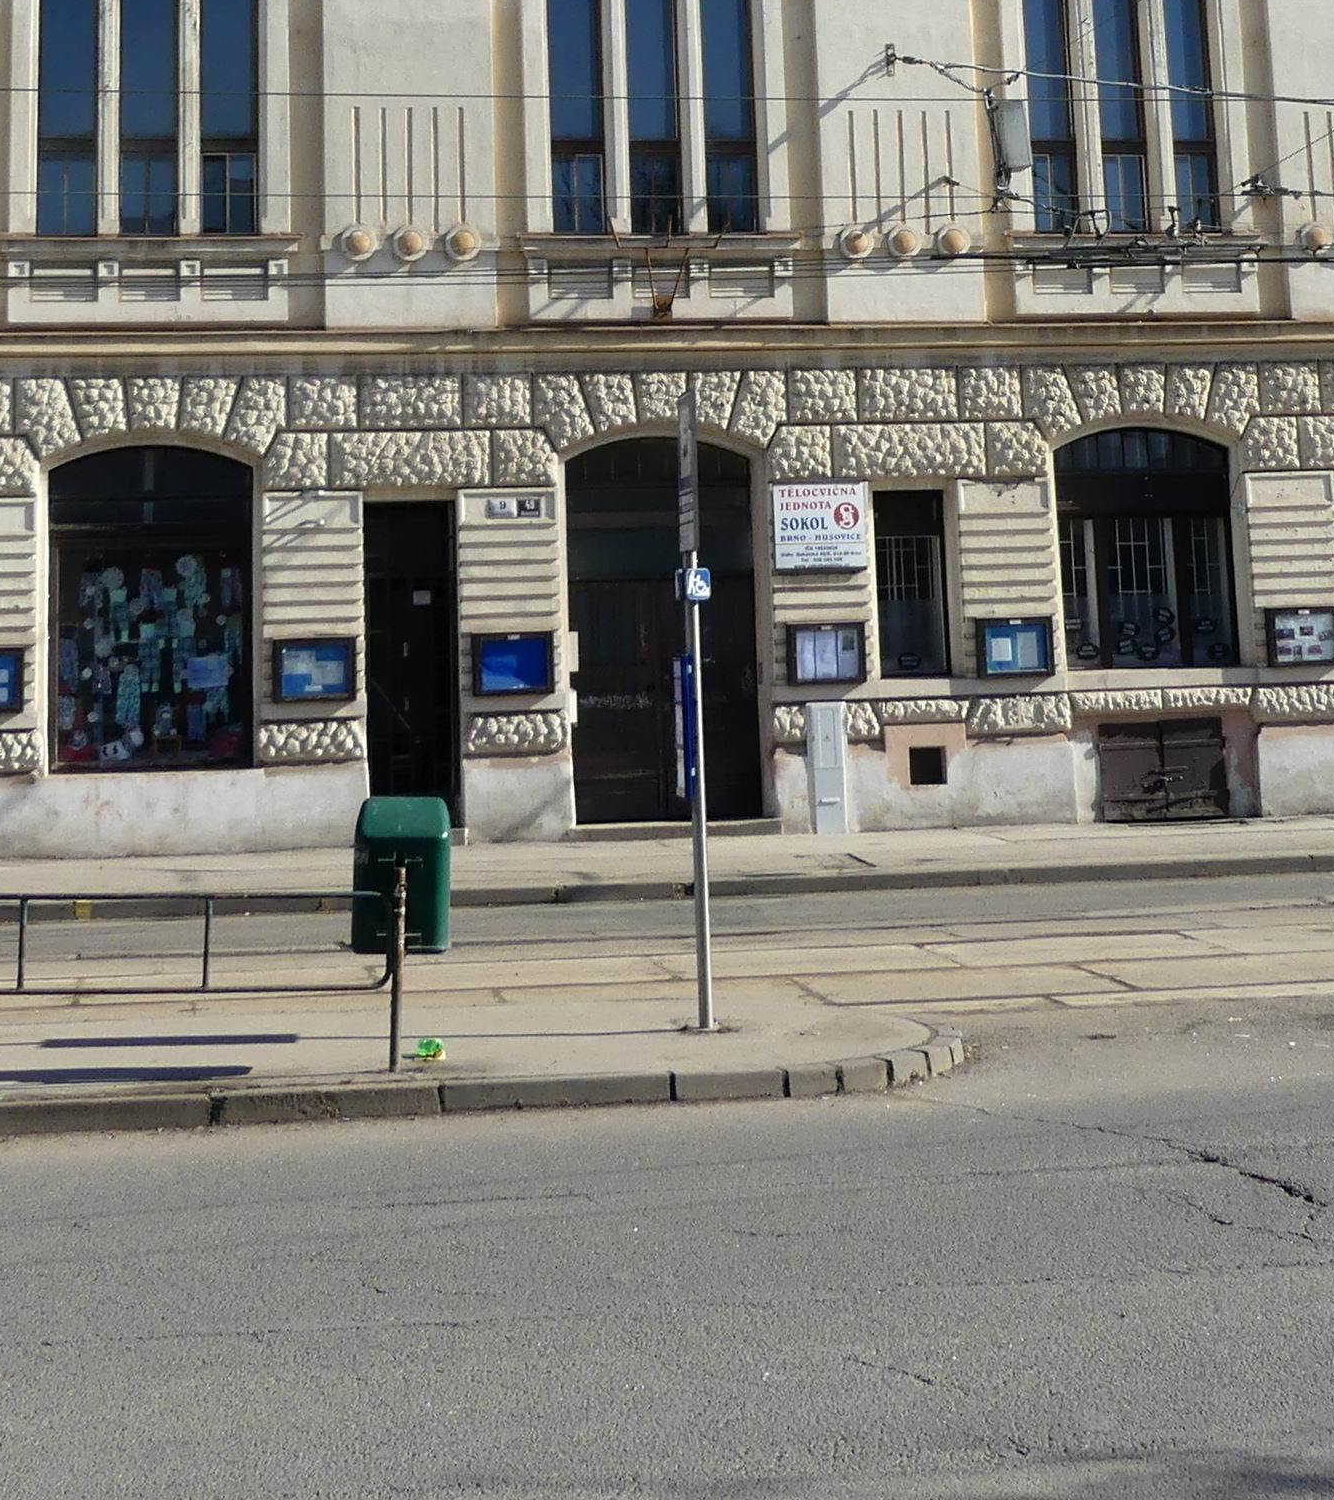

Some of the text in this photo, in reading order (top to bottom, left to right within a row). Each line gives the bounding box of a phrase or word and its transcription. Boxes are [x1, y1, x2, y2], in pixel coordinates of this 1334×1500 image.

[779, 500, 832, 511] JEDNOTA
[780, 516, 828, 531] SOKOL
[780, 534, 806, 542] BRNO
[815, 533, 861, 541] HUSOVICE
